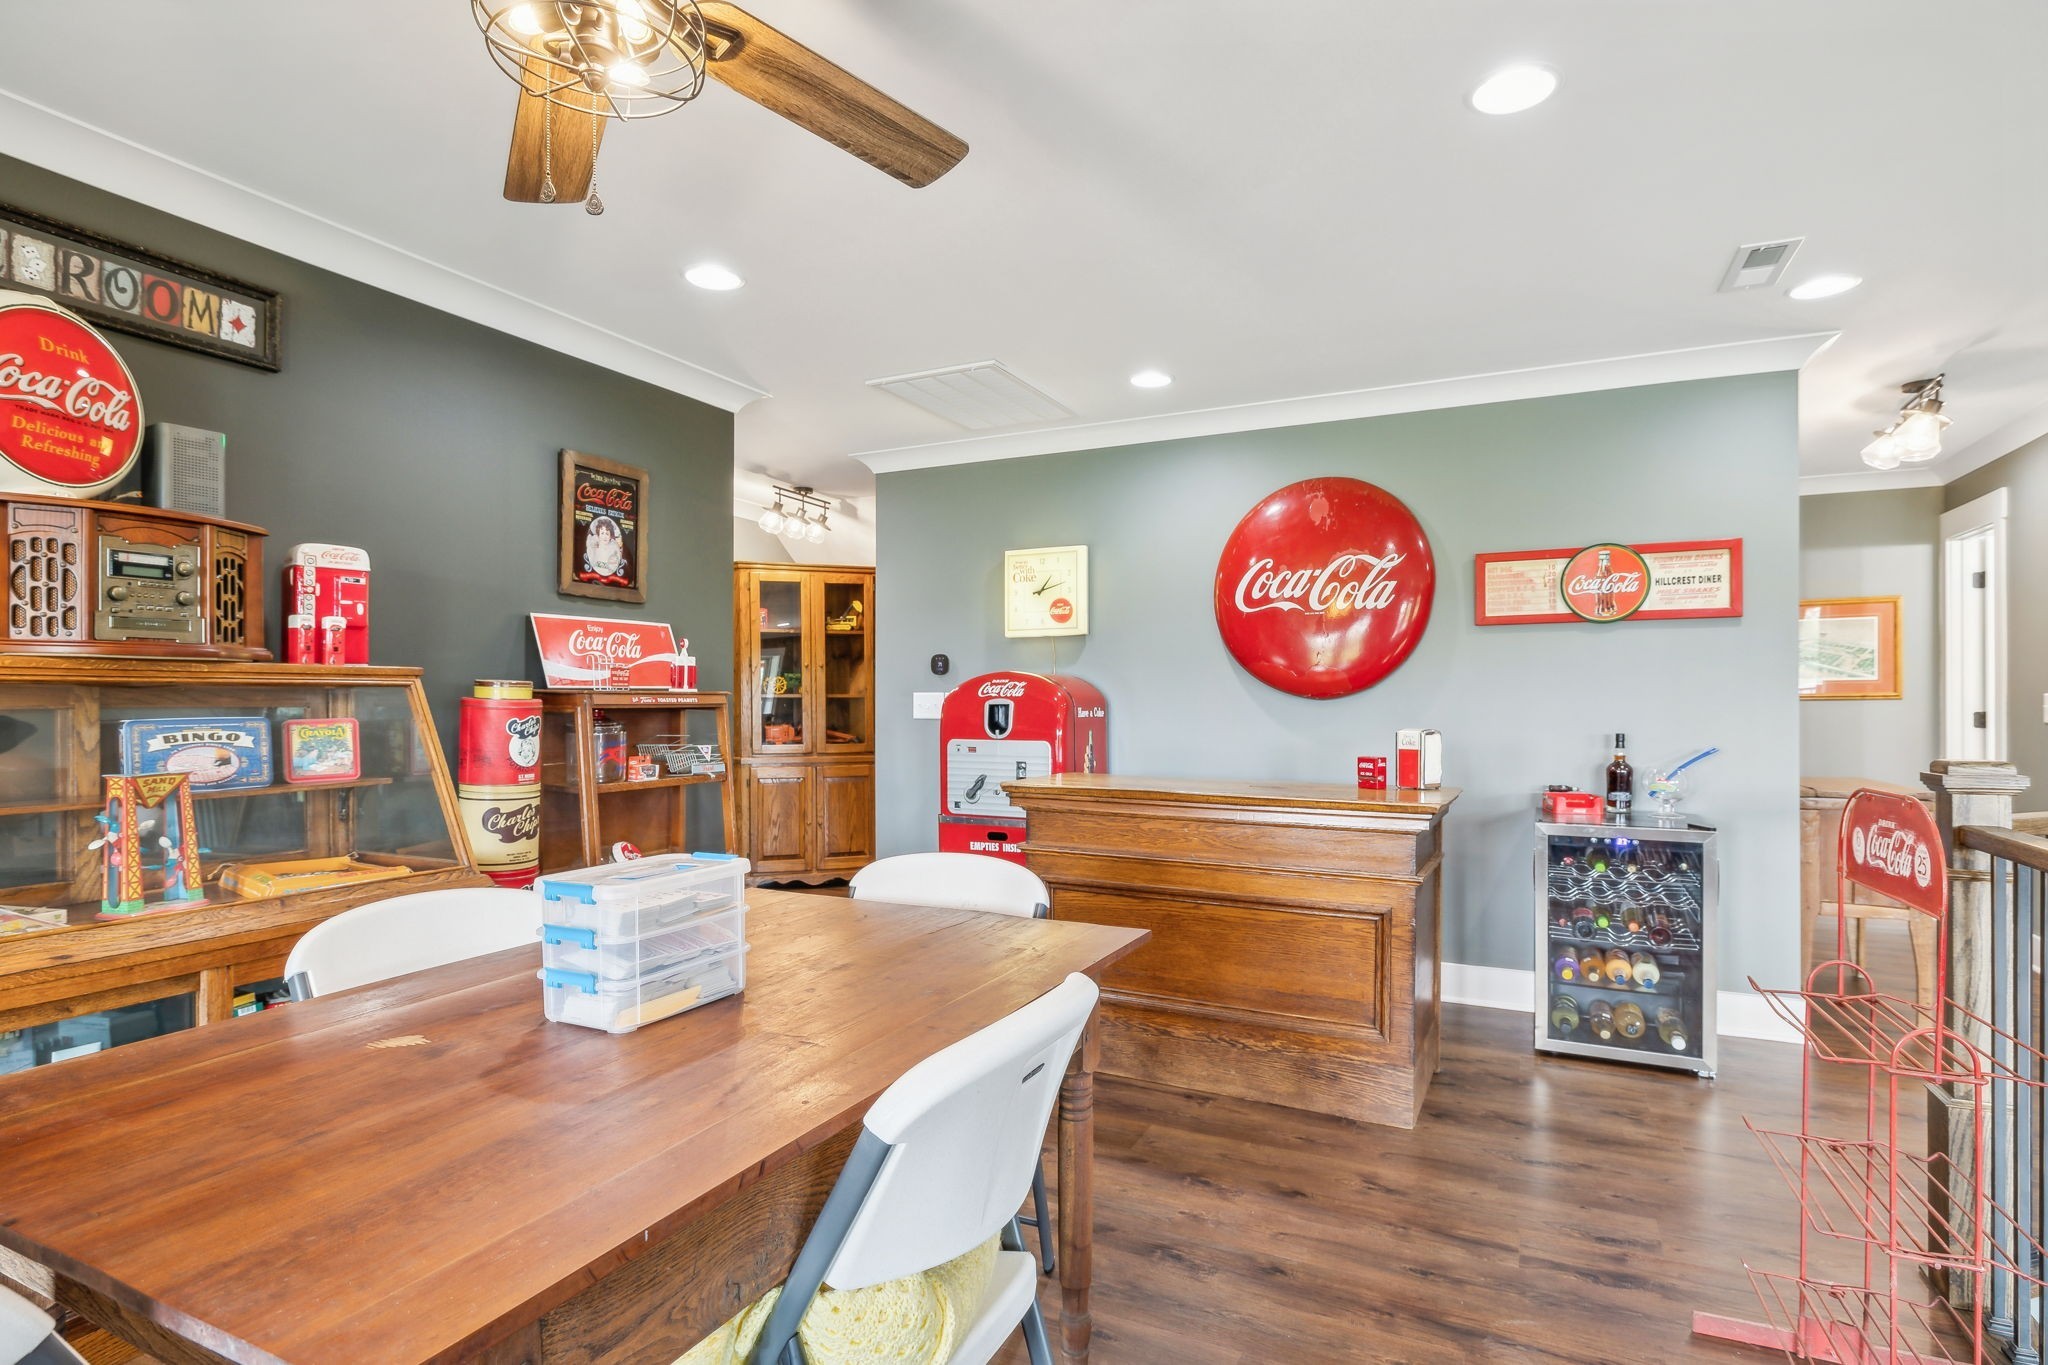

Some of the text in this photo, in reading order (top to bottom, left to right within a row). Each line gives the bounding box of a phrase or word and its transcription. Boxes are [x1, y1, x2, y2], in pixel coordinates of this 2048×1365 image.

[60, 249, 216, 336] ROOM
[38, 335, 90, 365] Drink
[12, 415, 84, 443] Delicious
[21, 434, 100, 469] Refreshing
[1013, 573, 1037, 584] Coke
[1234, 553, 1407, 613] Coca-Cola
[1568, 571, 1642, 596] Coca-Cola
[1655, 574, 1722, 586] HILLCREST DINER
[587, 624, 603, 633] Enjoy
[569, 629, 643, 659] Coca-Cola
[977, 681, 1028, 698] Coca-Cola
[1093, 707, 1104, 718] Coke
[162, 732, 241, 745] BINGO
[299, 725, 347, 740] CRAYOLA
[142, 777, 176, 788] SAND
[488, 803, 536, 831] Charles
[969, 841, 999, 852] EMPTIES
[1866, 824, 1917, 878] Coca-Cola
[1917, 854, 1928, 876] 25
